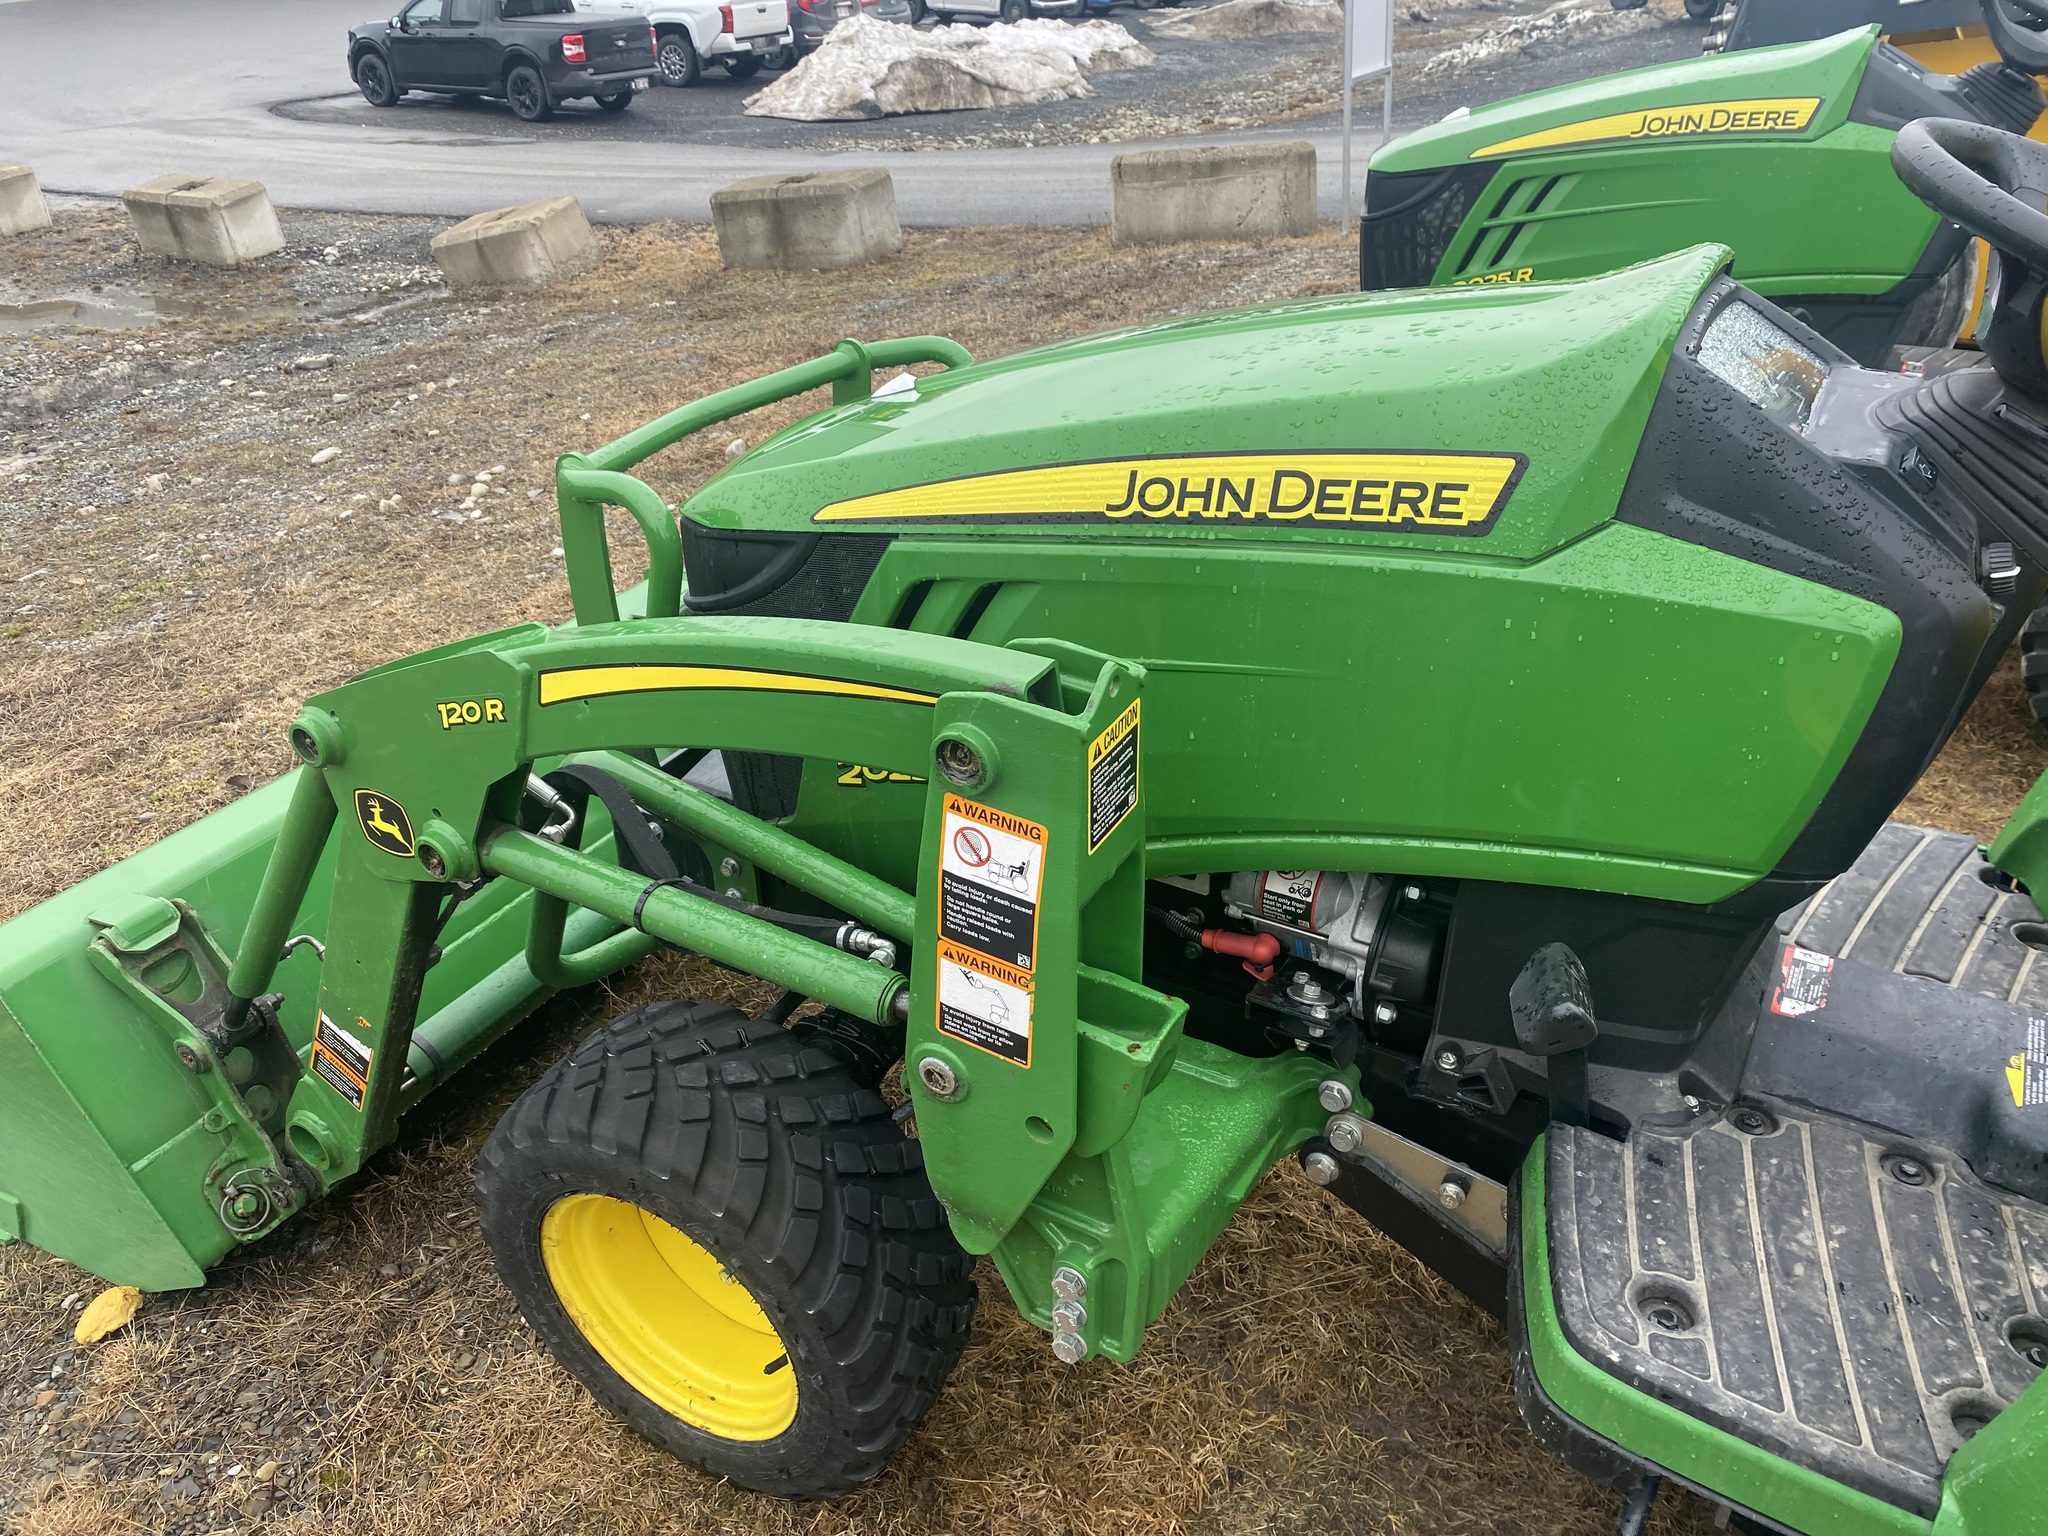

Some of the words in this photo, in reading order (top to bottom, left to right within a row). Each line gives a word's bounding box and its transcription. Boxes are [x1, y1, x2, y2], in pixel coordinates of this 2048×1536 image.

[1630, 113, 1704, 136] JOHN
[1709, 109, 1799, 129] DEERE
[1104, 469, 1254, 517] JOHN
[1269, 469, 1470, 520] DEERE
[1104, 702, 1137, 751] CAUTION
[964, 803, 1041, 840] WARNING
[944, 883, 951, 892] by
[952, 887, 969, 899] falling
[944, 877, 951, 885] To
[952, 880, 968, 891] avoid
[969, 887, 985, 899] injury
[994, 896, 1010, 907] death
[1011, 902, 1032, 915] caused
[1278, 897, 1291, 905] only
[947, 895, 954, 903] Do
[965, 902, 985, 915] handle
[987, 910, 1003, 921] round
[947, 901, 960, 912] large
[962, 908, 980, 920] square
[947, 915, 968, 927] caution.
[947, 908, 966, 921] Handle
[967, 916, 984, 928] raised
[985, 923, 1001, 934] loads
[1002, 930, 1015, 939] with
[947, 921, 961, 933] Carry
[962, 927, 978, 938] loads
[979, 933, 991, 943] low.
[956, 951, 1029, 989] WARNING
[945, 1019, 960, 1030] riders
[970, 1029, 986, 1040] loader
[950, 1008, 964, 1019] avoid
[966, 1015, 981, 1026] injury
[983, 1022, 995, 1031] from
[953, 1017, 962, 1025] not
[964, 1022, 977, 1032] work
[978, 1028, 990, 1037] from
[999, 1036, 1013, 1046] allow
[328, 1054, 360, 1087] WARNING
